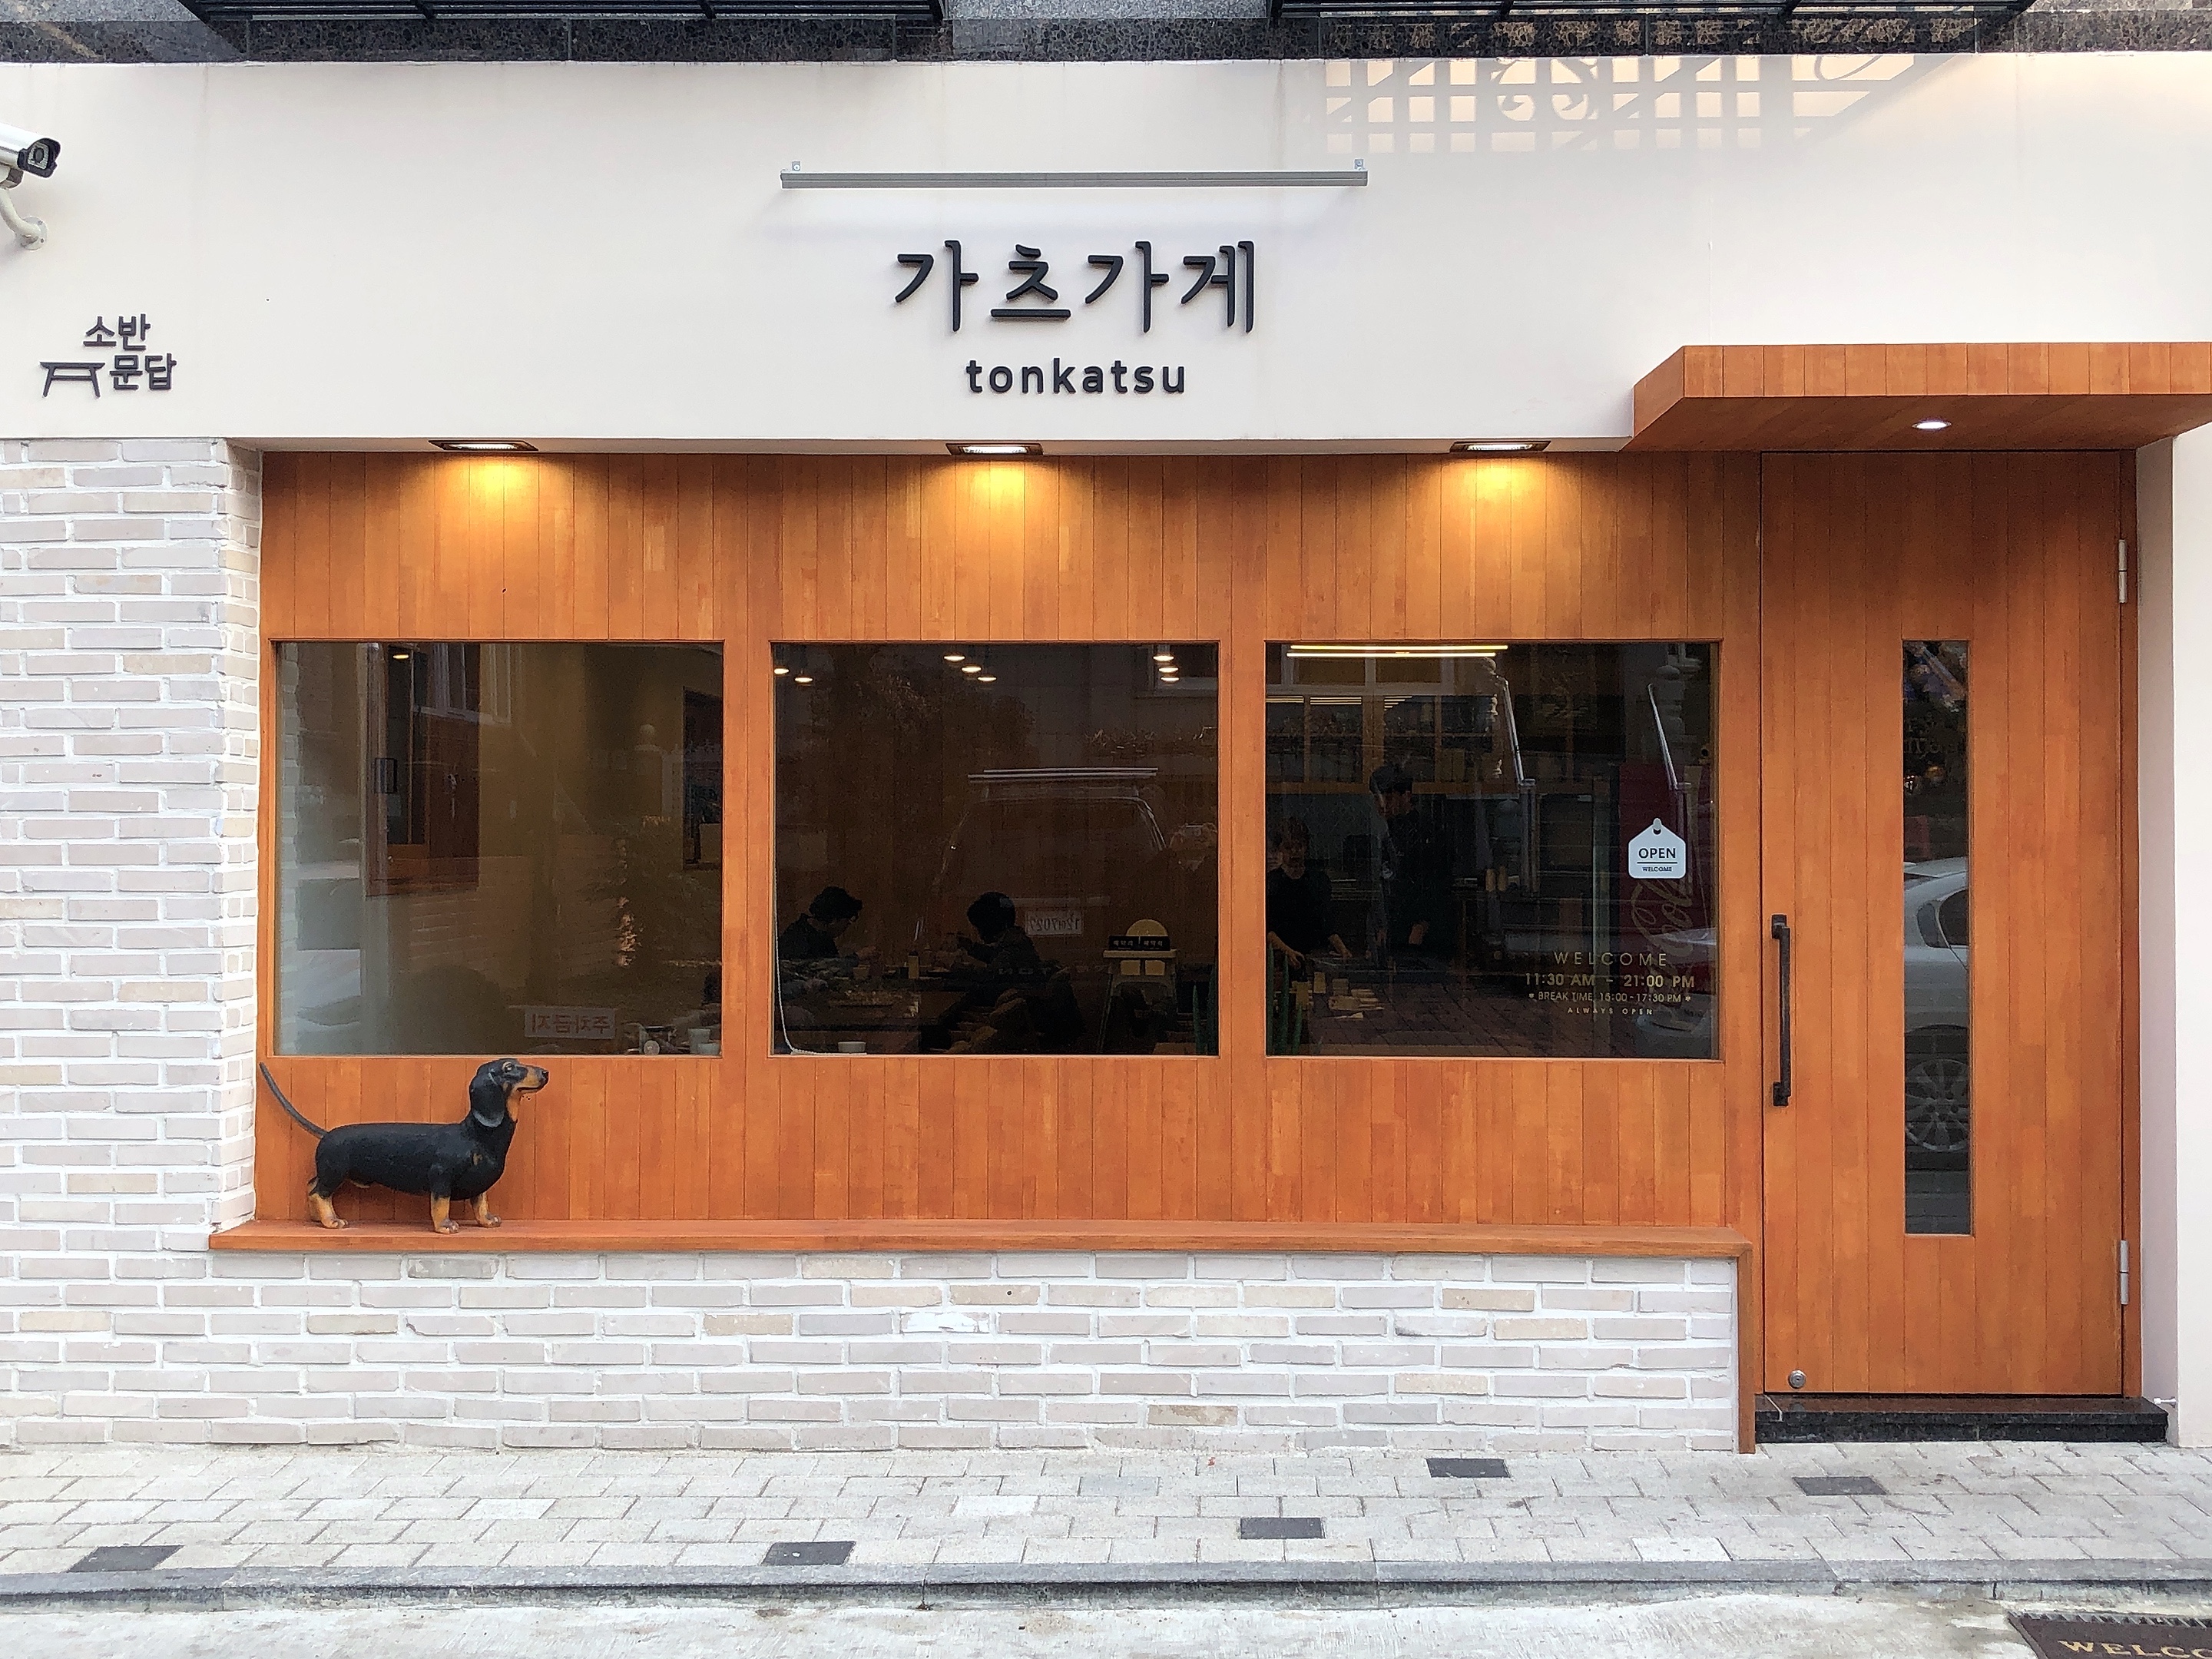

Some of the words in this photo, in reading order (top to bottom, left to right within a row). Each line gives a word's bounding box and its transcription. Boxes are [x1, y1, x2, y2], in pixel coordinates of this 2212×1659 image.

[895, 240, 1254, 334] 가츠가게
[82, 313, 151, 352] 소반
[109, 353, 177, 391] 문답
[965, 357, 1184, 395] tonkatsu
[1637, 847, 1677, 859] OPEN
[1554, 951, 1667, 967] WELCOME
[1525, 972, 1565, 986] 11:30
[1570, 973, 1596, 986] AM
[1624, 974, 1664, 988] 21:00
[1672, 975, 1695, 988] PM
[1538, 992, 1568, 1001] BREAK
[1667, 994, 1681, 1002] PM
